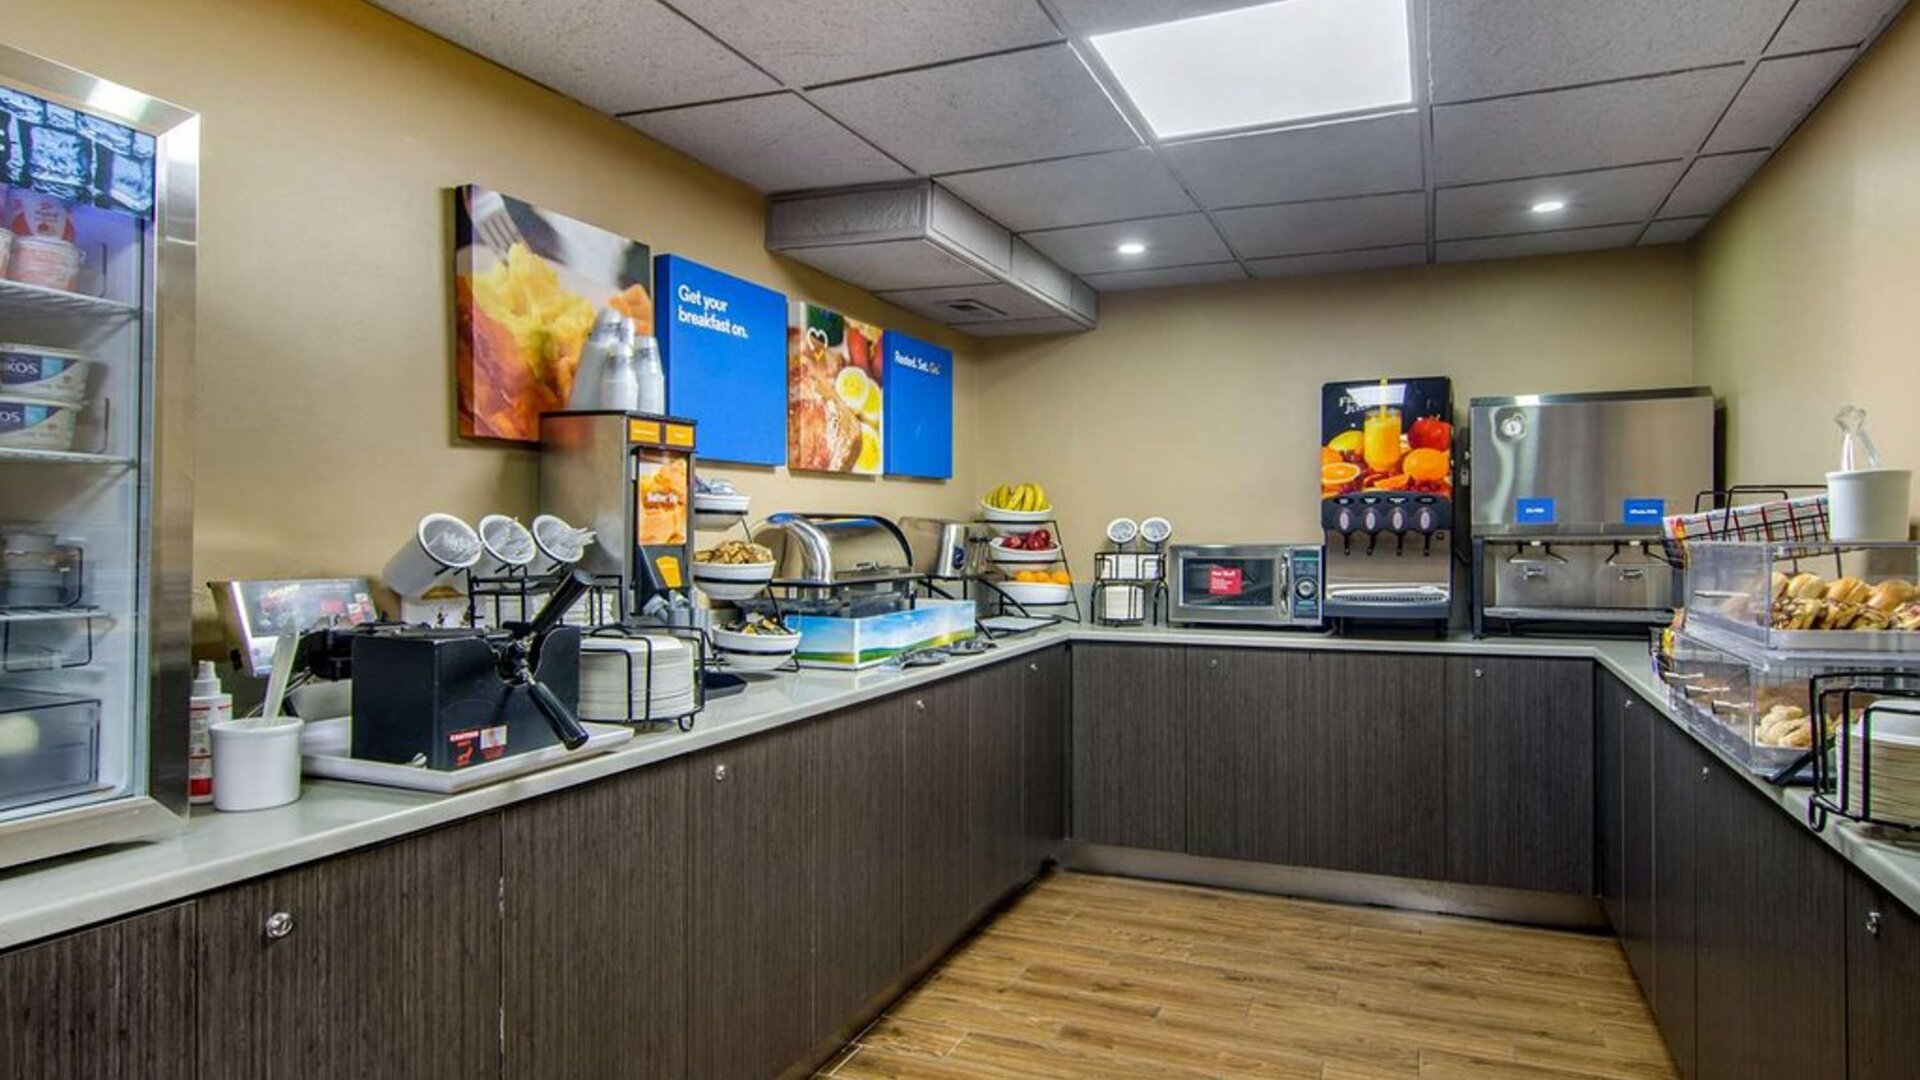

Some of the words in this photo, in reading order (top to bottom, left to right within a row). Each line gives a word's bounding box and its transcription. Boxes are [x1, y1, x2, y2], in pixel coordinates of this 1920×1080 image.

[678, 284, 702, 306] Get
[702, 294, 728, 313] your
[678, 304, 730, 334] breakfast
[731, 323, 748, 339] on.
